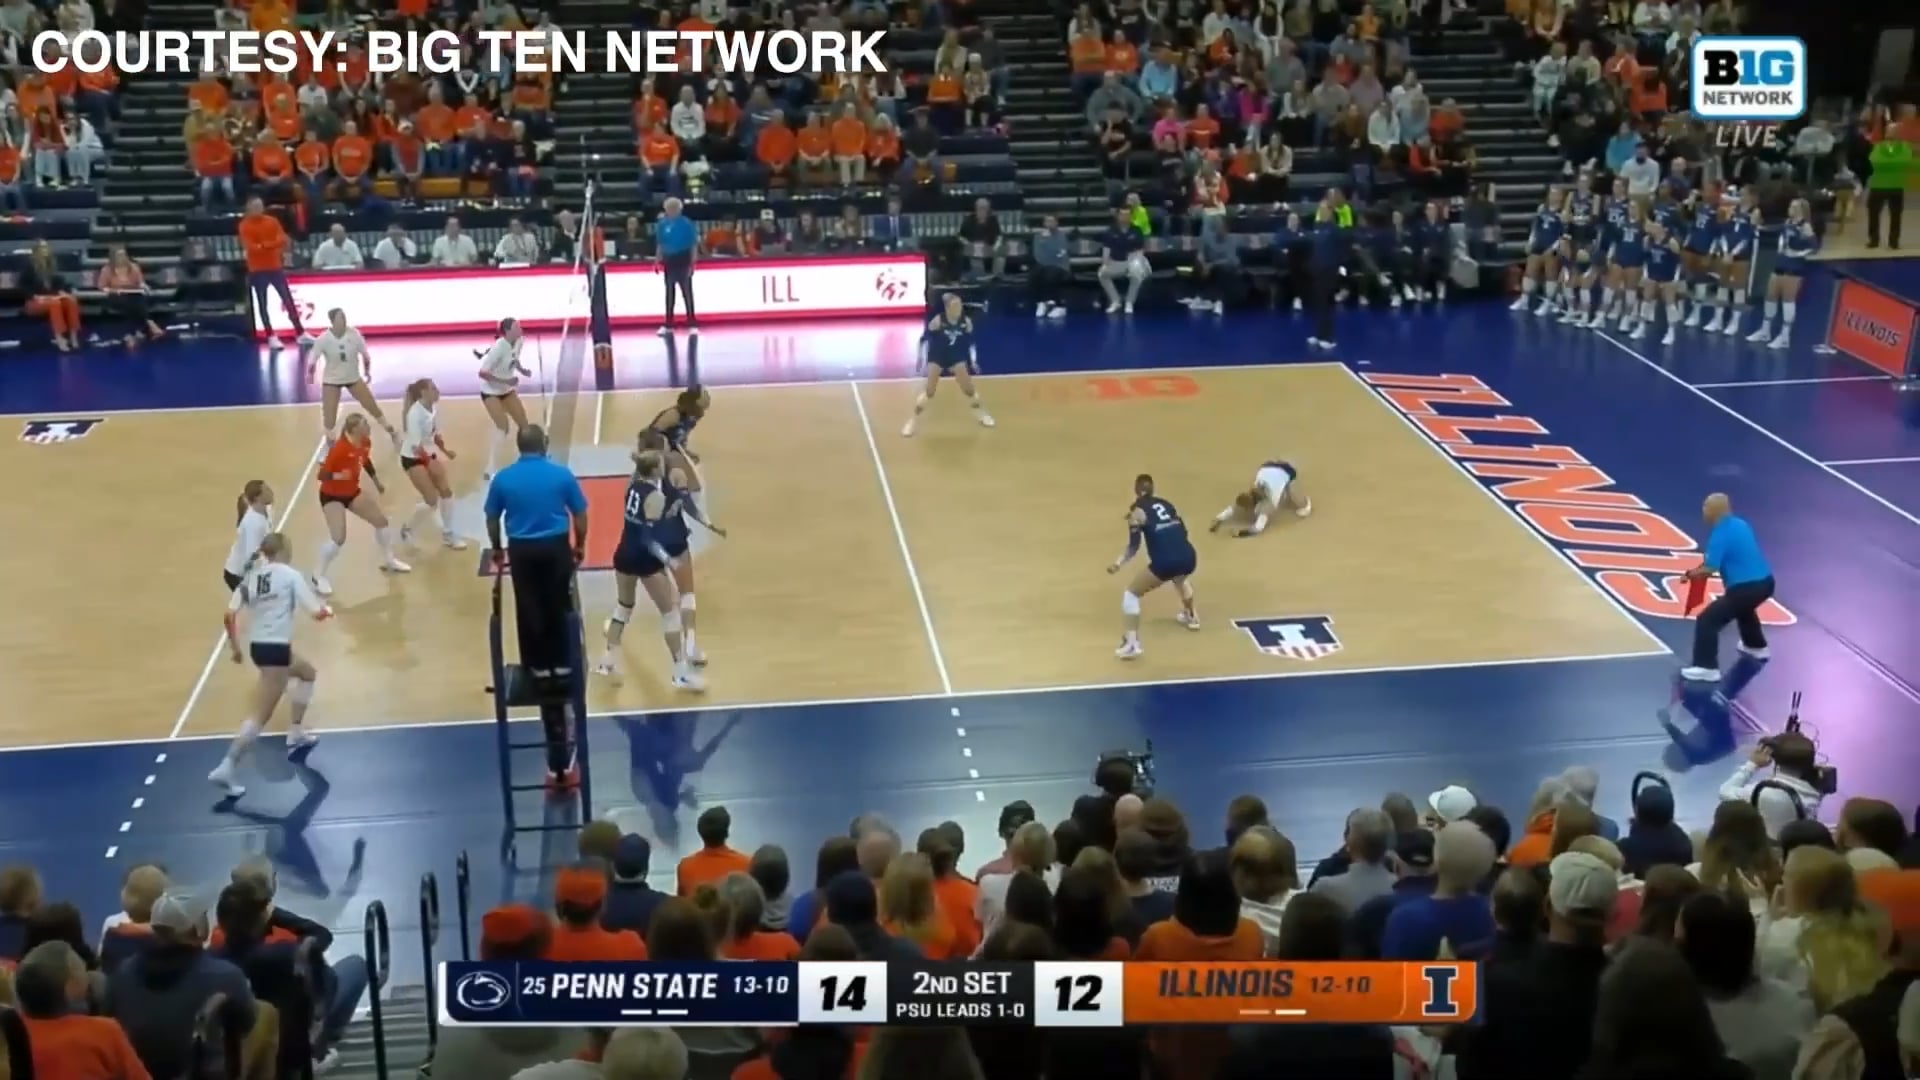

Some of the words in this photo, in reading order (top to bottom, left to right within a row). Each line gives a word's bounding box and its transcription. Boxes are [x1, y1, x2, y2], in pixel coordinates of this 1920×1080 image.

[762, 274, 800, 304] ILL
[1841, 308, 1902, 348] ILLINOIS
[1152, 502, 1171, 521] 2
